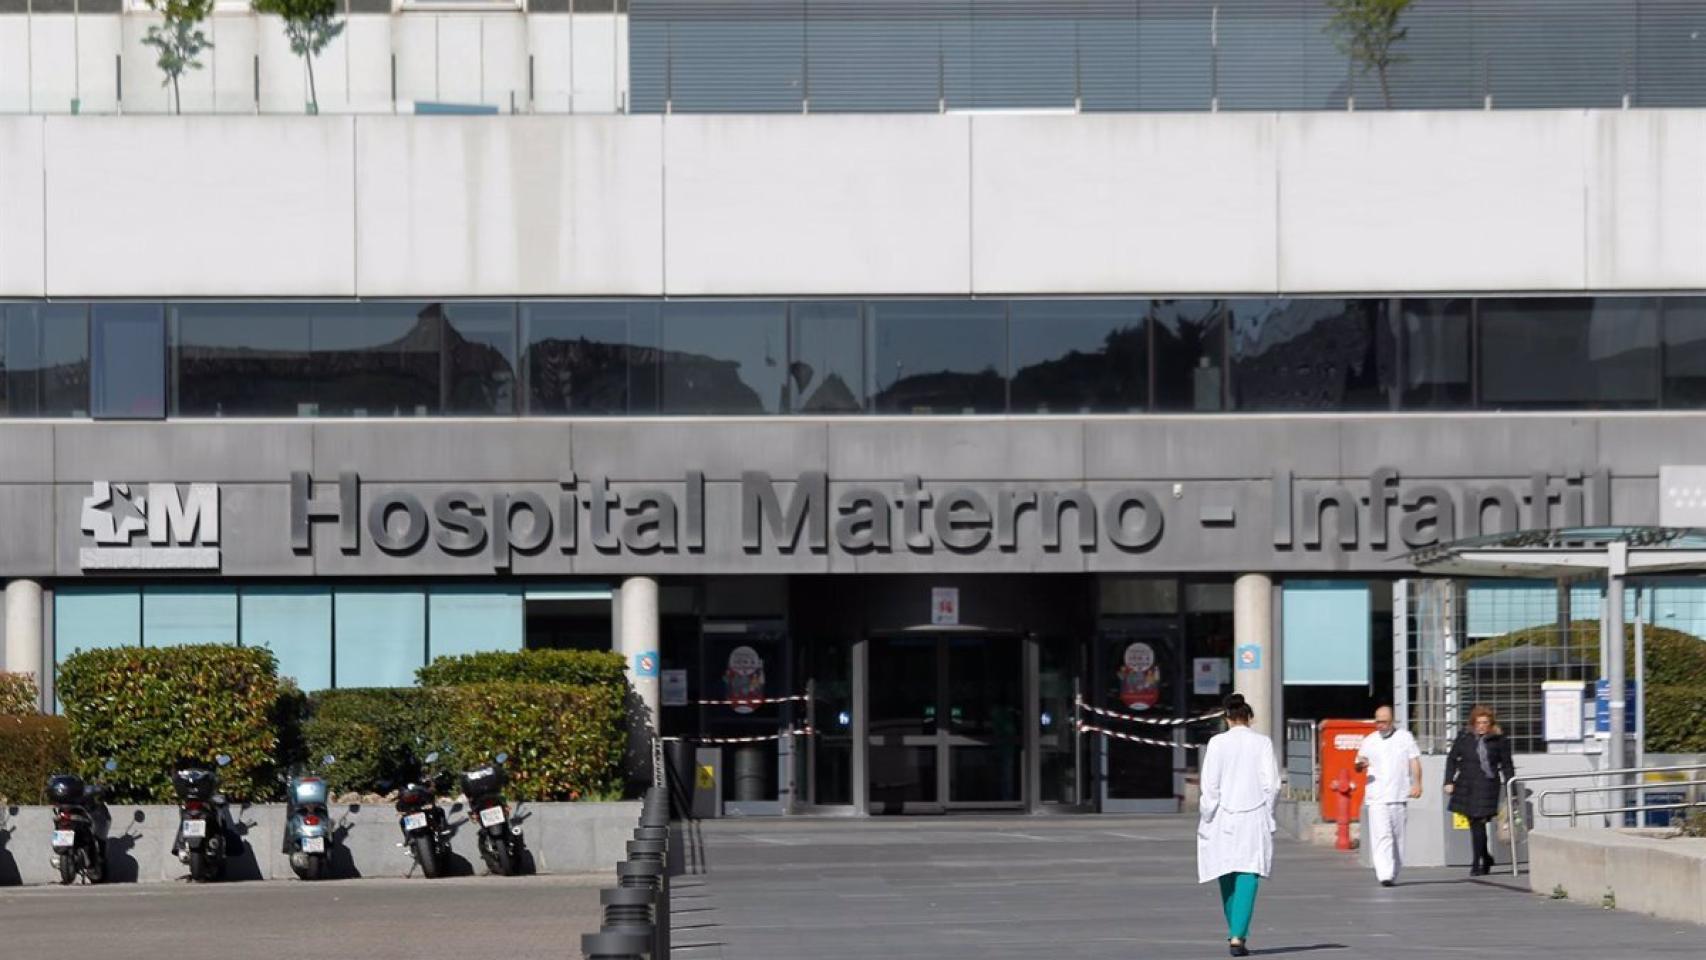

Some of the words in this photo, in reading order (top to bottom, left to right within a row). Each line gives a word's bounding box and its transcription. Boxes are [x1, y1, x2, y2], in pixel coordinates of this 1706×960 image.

[290, 470, 705, 572] Hospital
[741, 470, 1164, 555] Materno
[1201, 504, 1236, 526] -
[1272, 467, 1610, 550] Infantil
